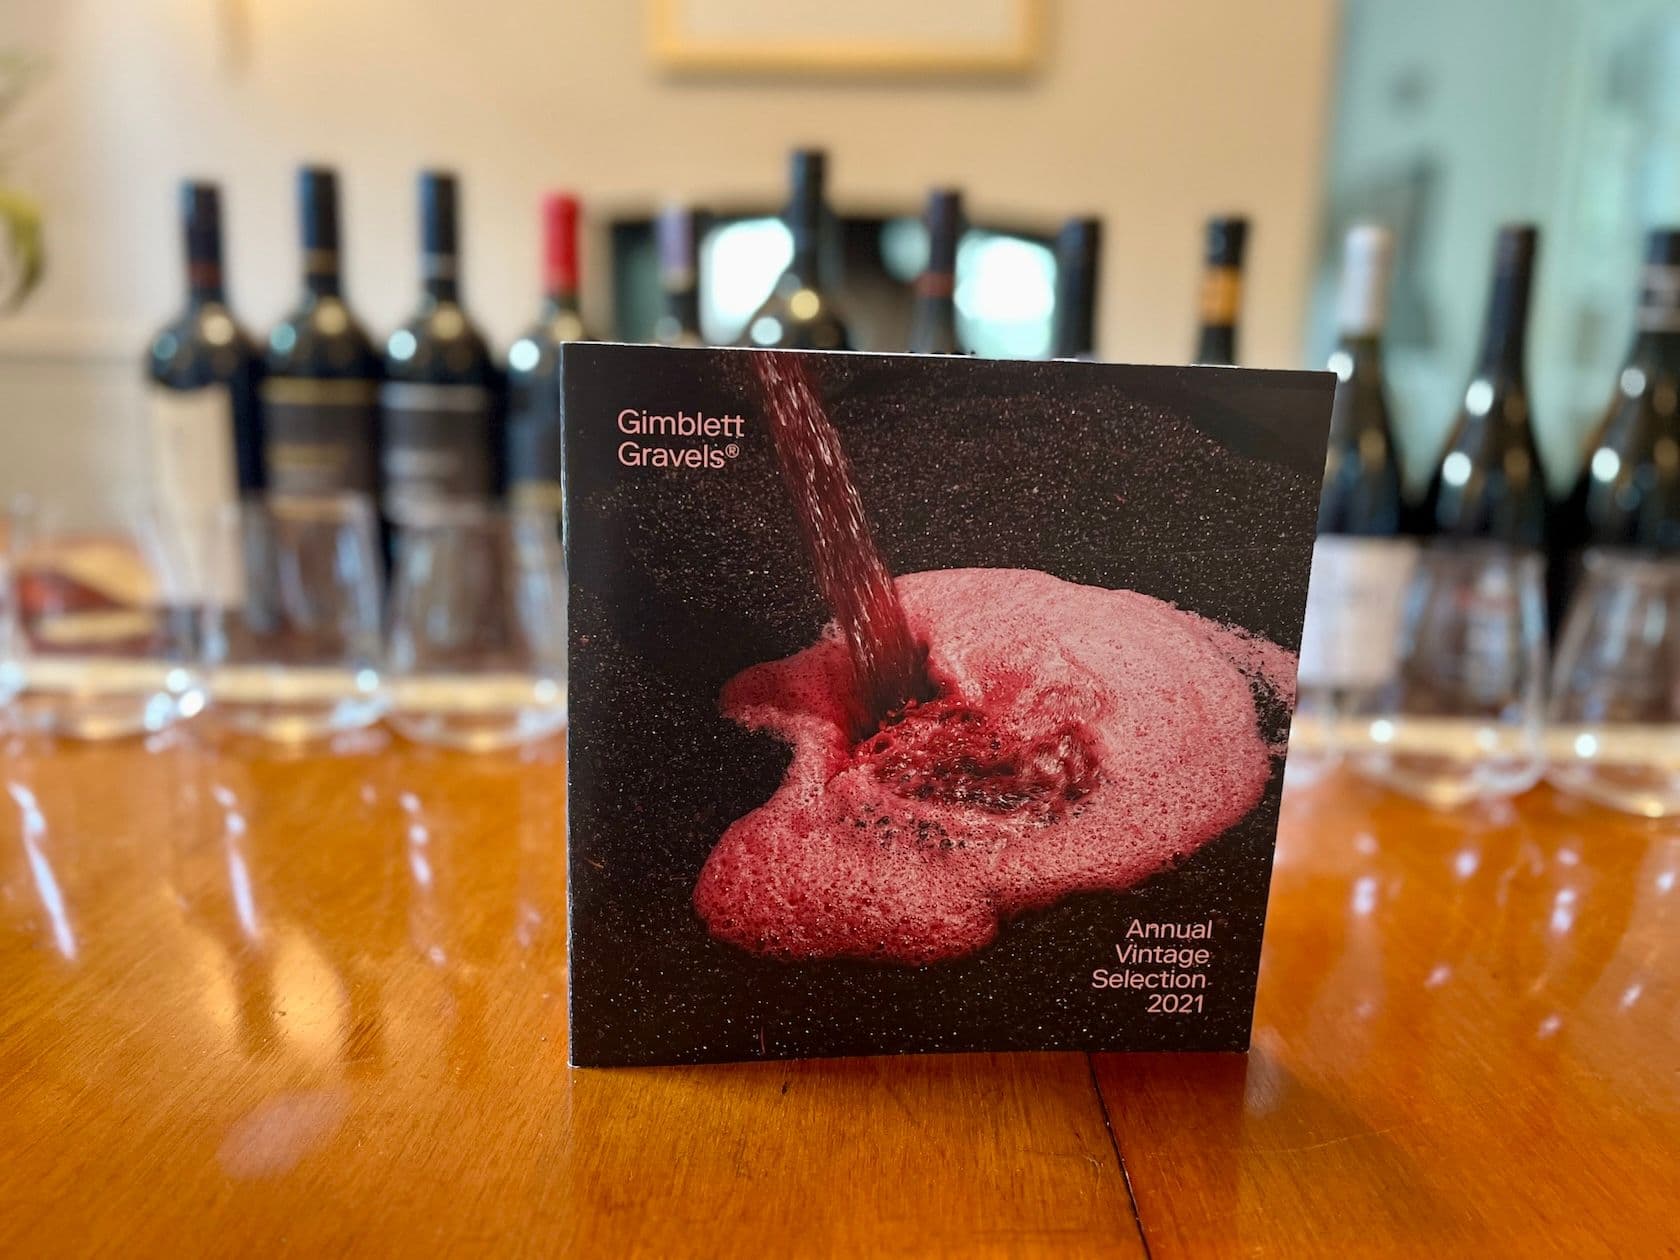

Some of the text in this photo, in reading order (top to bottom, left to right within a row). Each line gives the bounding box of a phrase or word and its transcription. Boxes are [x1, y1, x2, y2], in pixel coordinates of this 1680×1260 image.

[617, 408, 746, 438] Gimblett
[1125, 918, 1213, 939] Annual
[1115, 943, 1210, 968] Vintage
[1091, 968, 1207, 989] Selection
[1147, 993, 1204, 1014] 2021
